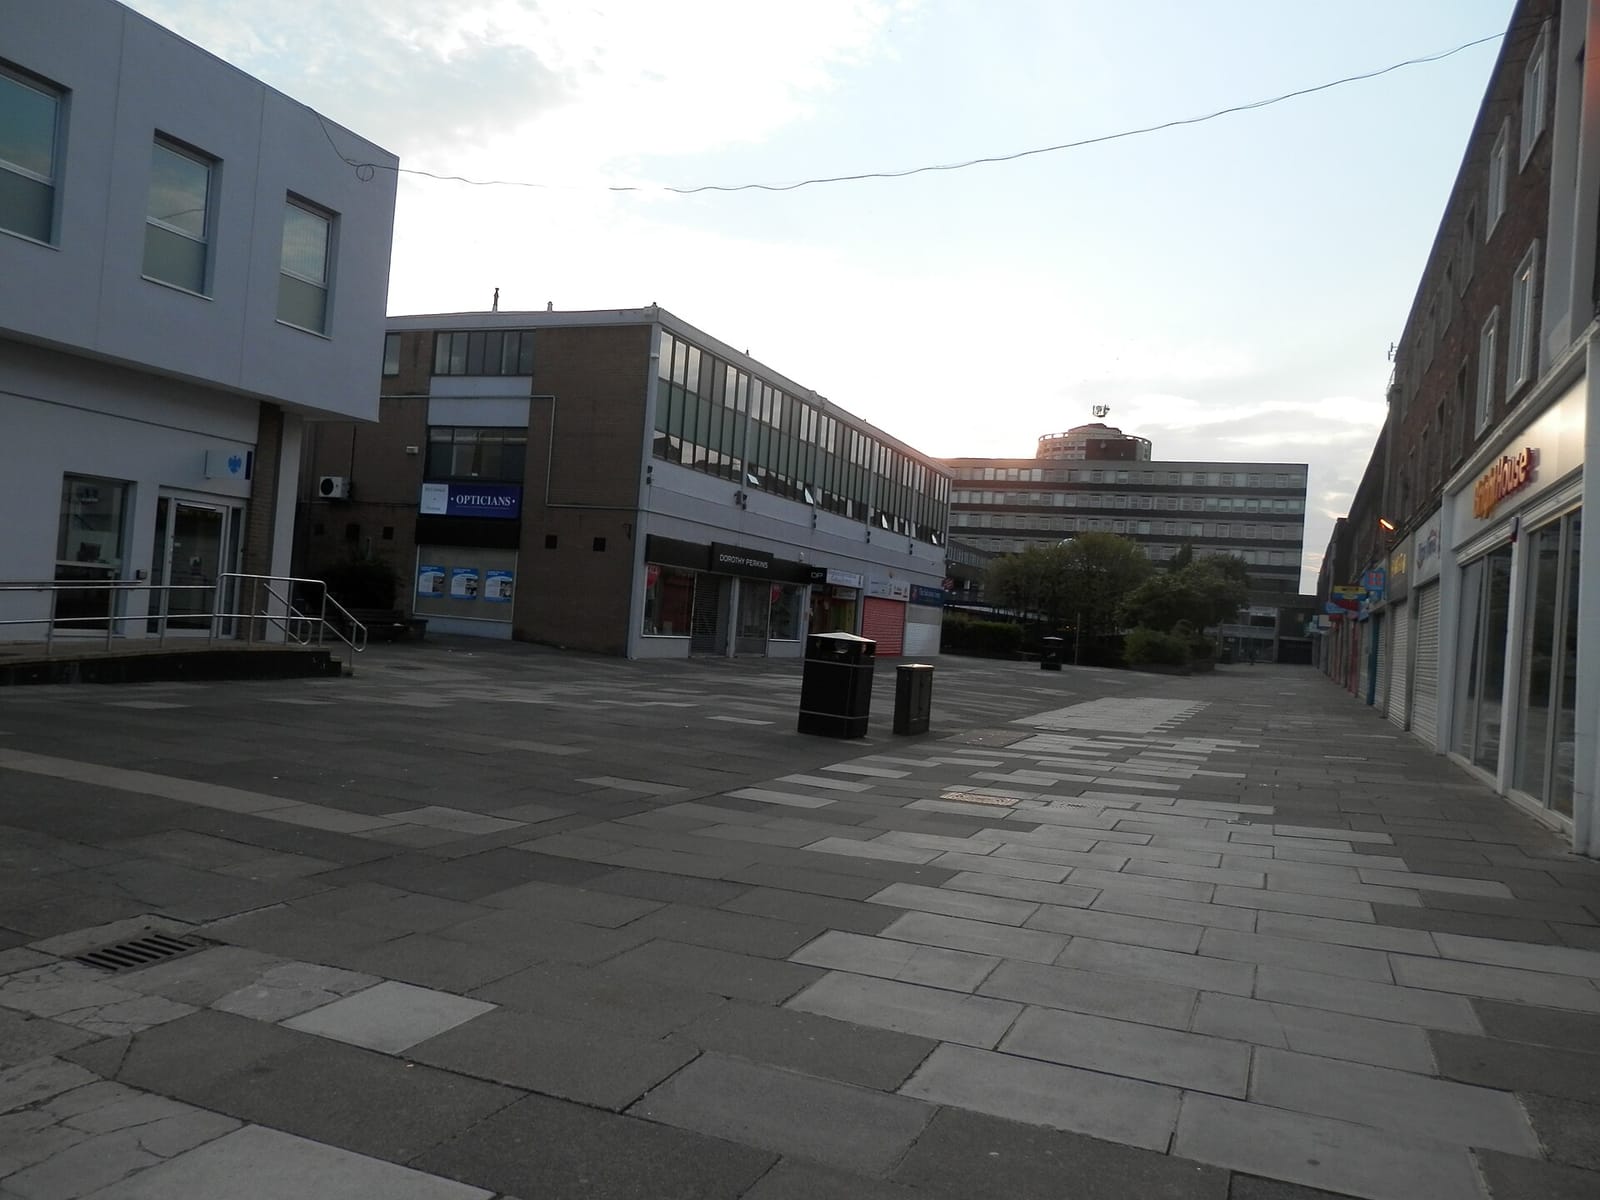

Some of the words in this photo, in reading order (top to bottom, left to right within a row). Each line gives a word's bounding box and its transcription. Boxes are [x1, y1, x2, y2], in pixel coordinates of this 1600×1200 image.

[456, 494, 511, 506] OPTICIANS
[719, 554, 745, 565] DOROTHY
[745, 558, 769, 569] PERKINS
